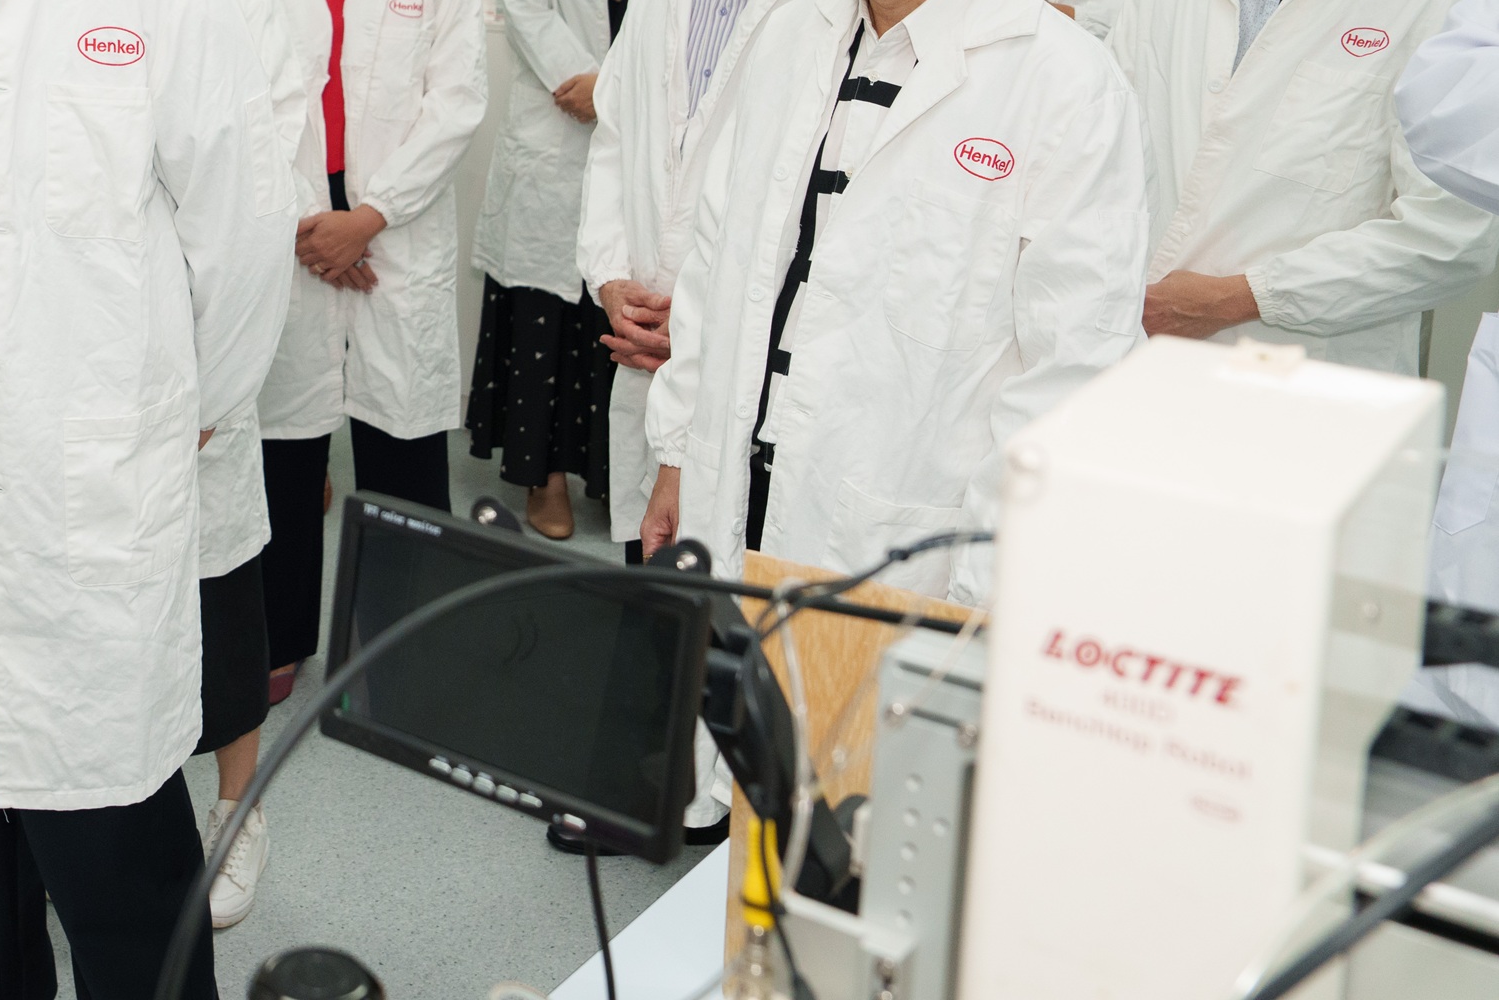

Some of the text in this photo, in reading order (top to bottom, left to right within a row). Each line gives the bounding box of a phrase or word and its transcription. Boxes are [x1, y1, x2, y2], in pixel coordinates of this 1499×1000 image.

[393, 1, 422, 11] Henk
[84, 37, 140, 55] Henkel
[960, 144, 1012, 173] Henkel
[1044, 630, 1242, 706] LOCTITE
